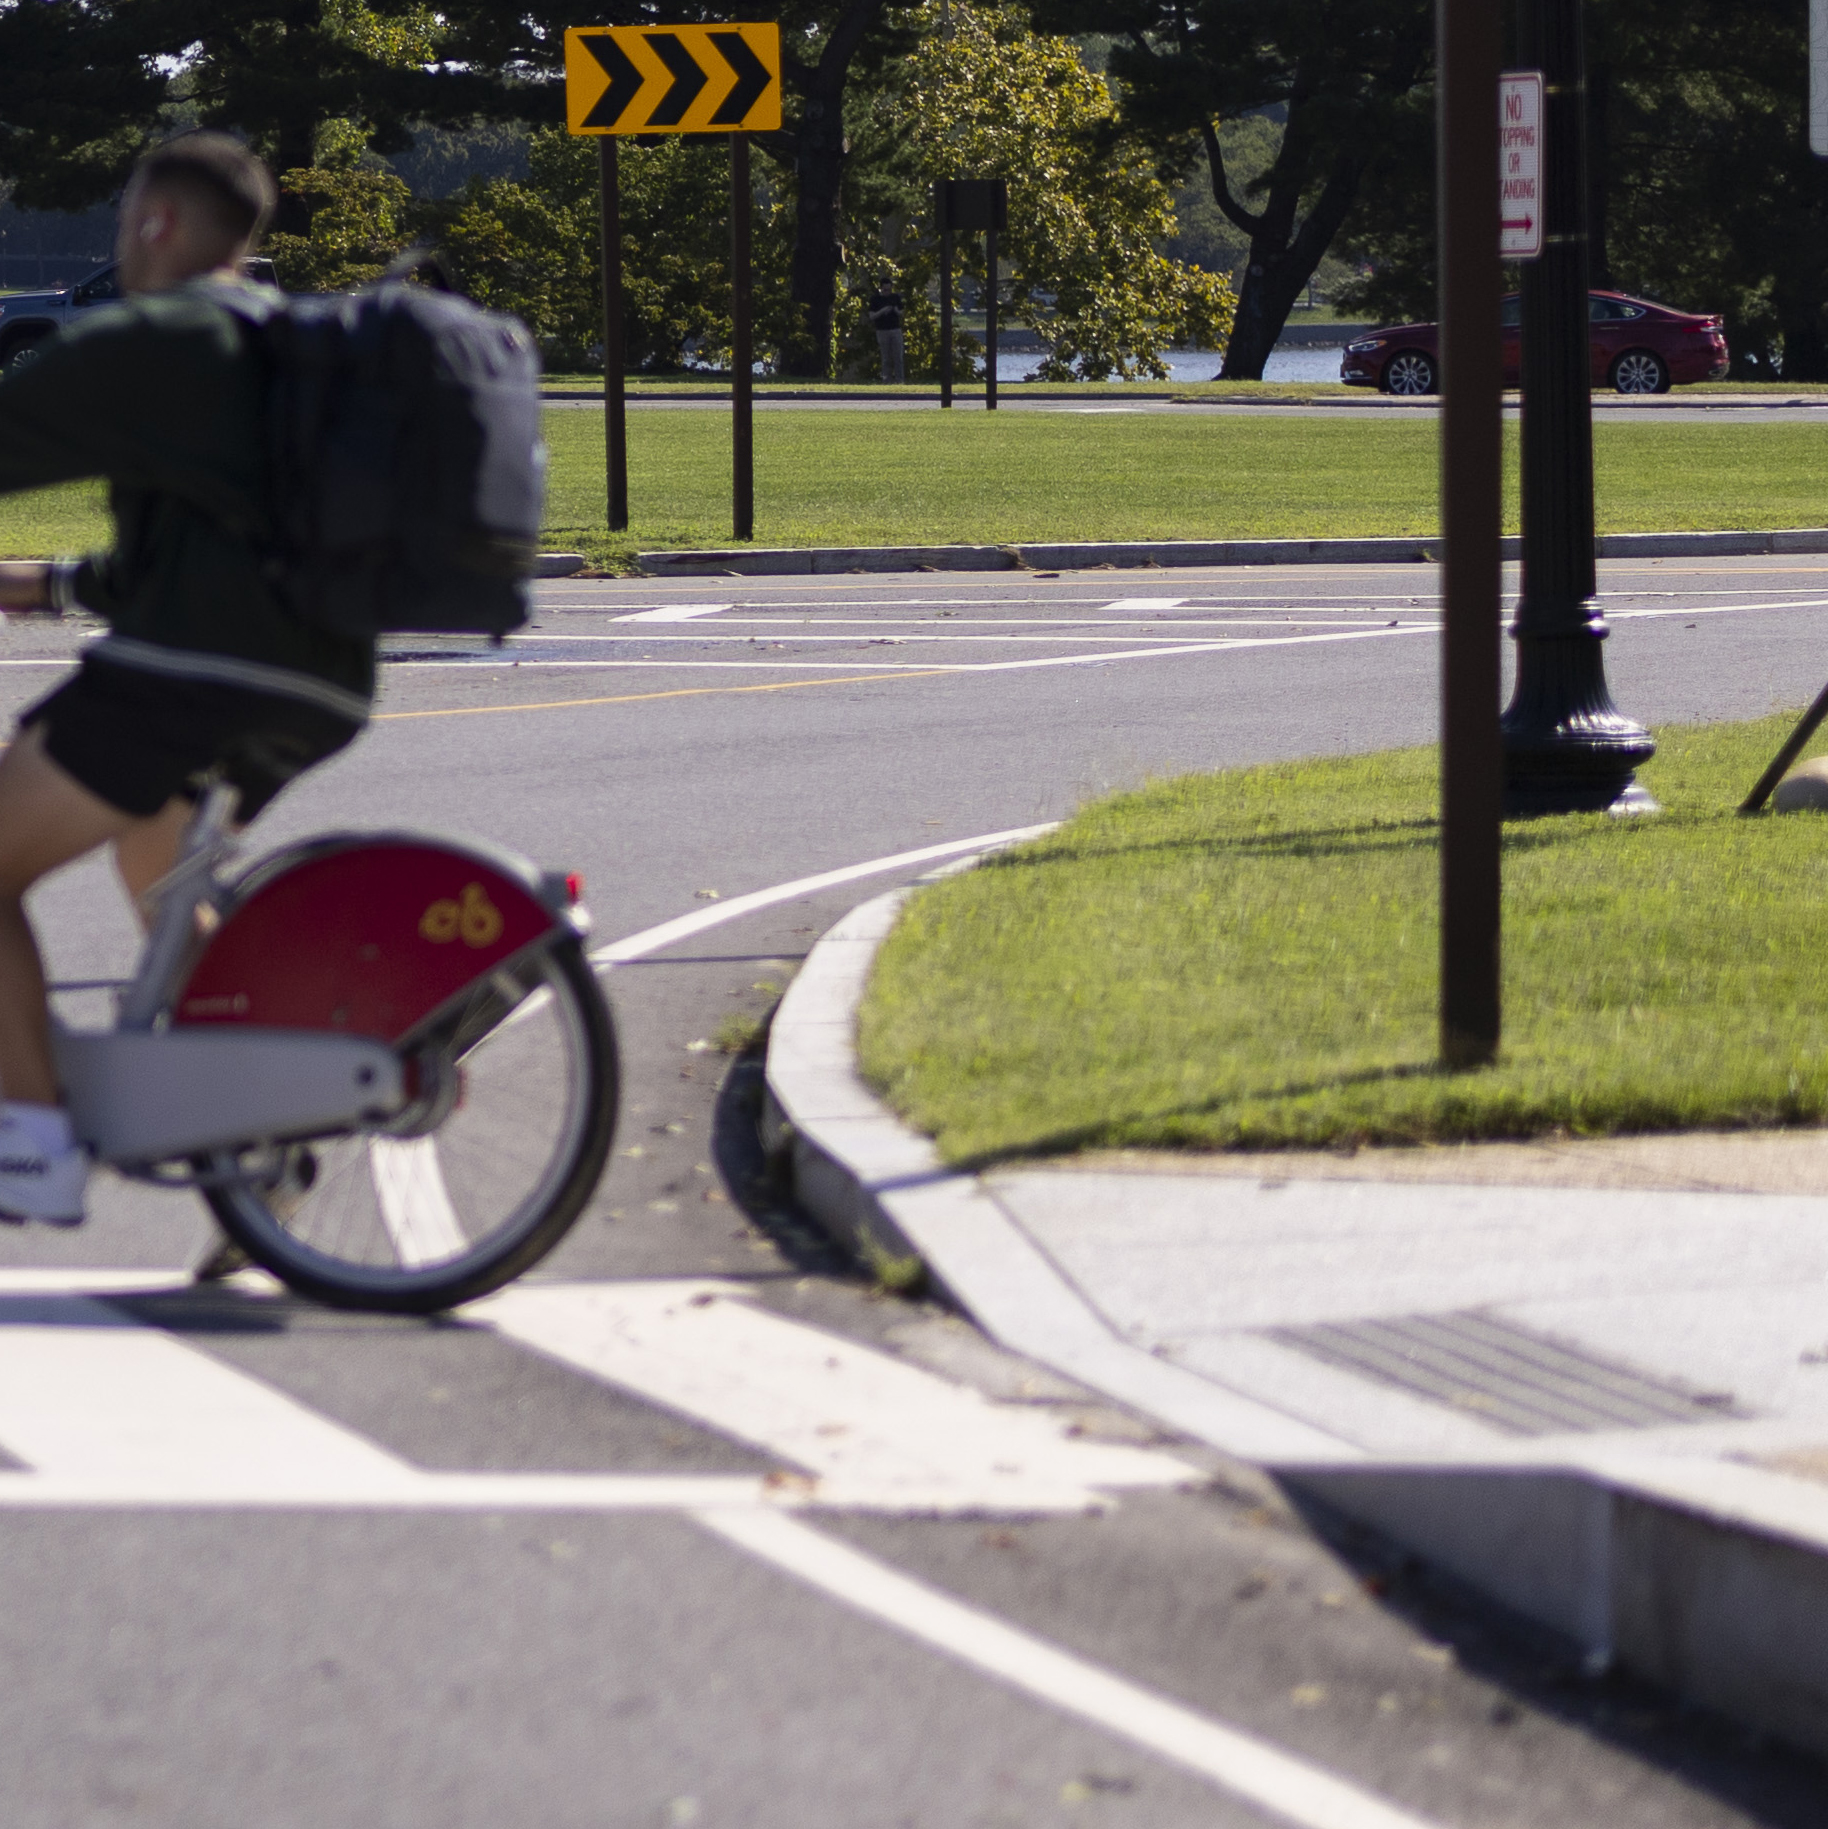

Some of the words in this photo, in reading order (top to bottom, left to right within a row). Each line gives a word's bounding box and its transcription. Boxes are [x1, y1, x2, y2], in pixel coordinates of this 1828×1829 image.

[1505, 93, 1522, 121] NO
[1500, 124, 1535, 146] TOPPING
[1508, 152, 1520, 174] OR
[1500, 179, 1535, 200] TANDING
